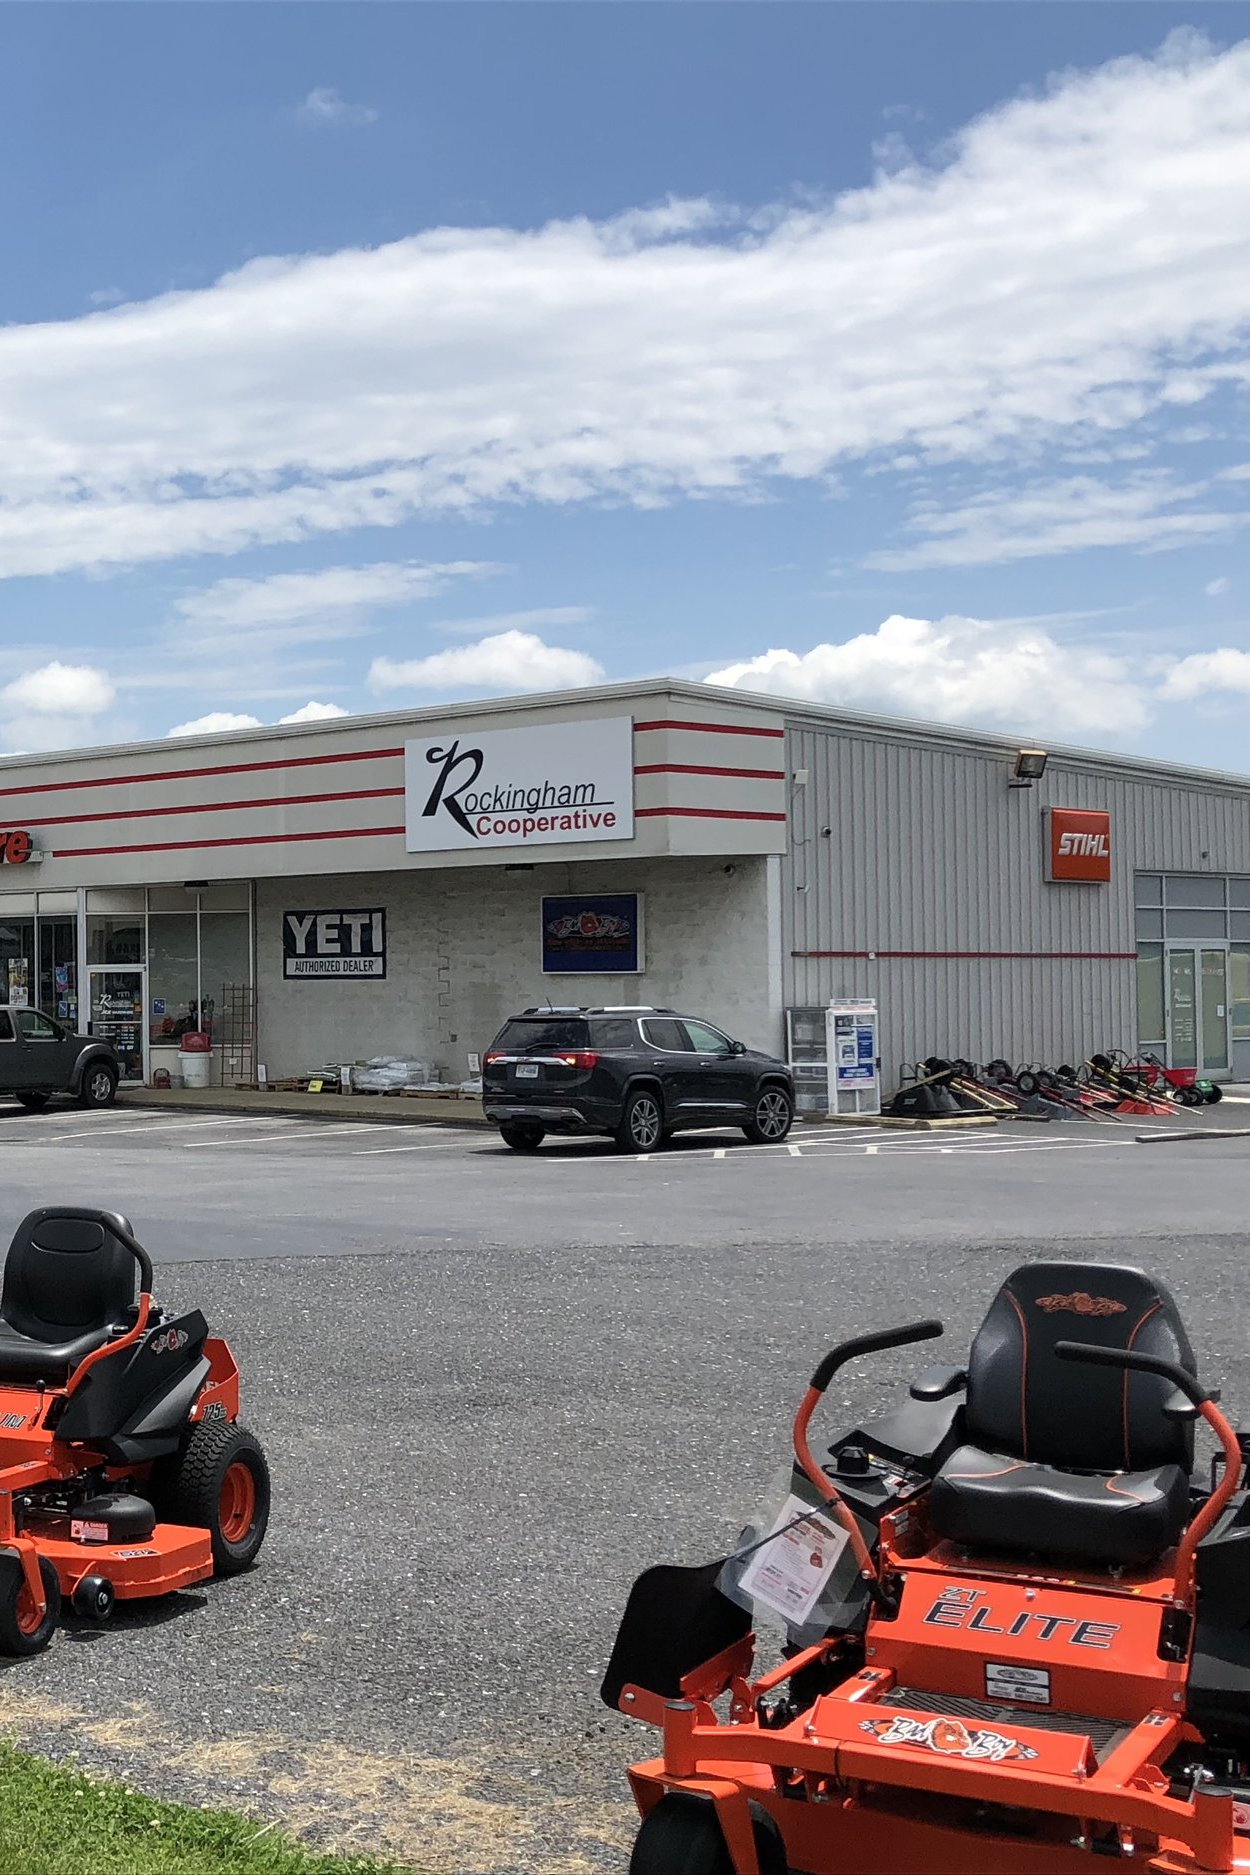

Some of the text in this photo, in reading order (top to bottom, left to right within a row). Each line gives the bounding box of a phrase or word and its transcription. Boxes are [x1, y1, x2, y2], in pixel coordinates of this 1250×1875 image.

[422, 740, 596, 839] Rockingham
[476, 811, 617, 838] Cooperative
[1057, 832, 1109, 857] STIHL
[286, 912, 383, 954] YETI
[294, 960, 374, 973] AUTHORIZED DEALER
[938, 1586, 987, 1603] ZT
[922, 1600, 1121, 1649] ELITE
